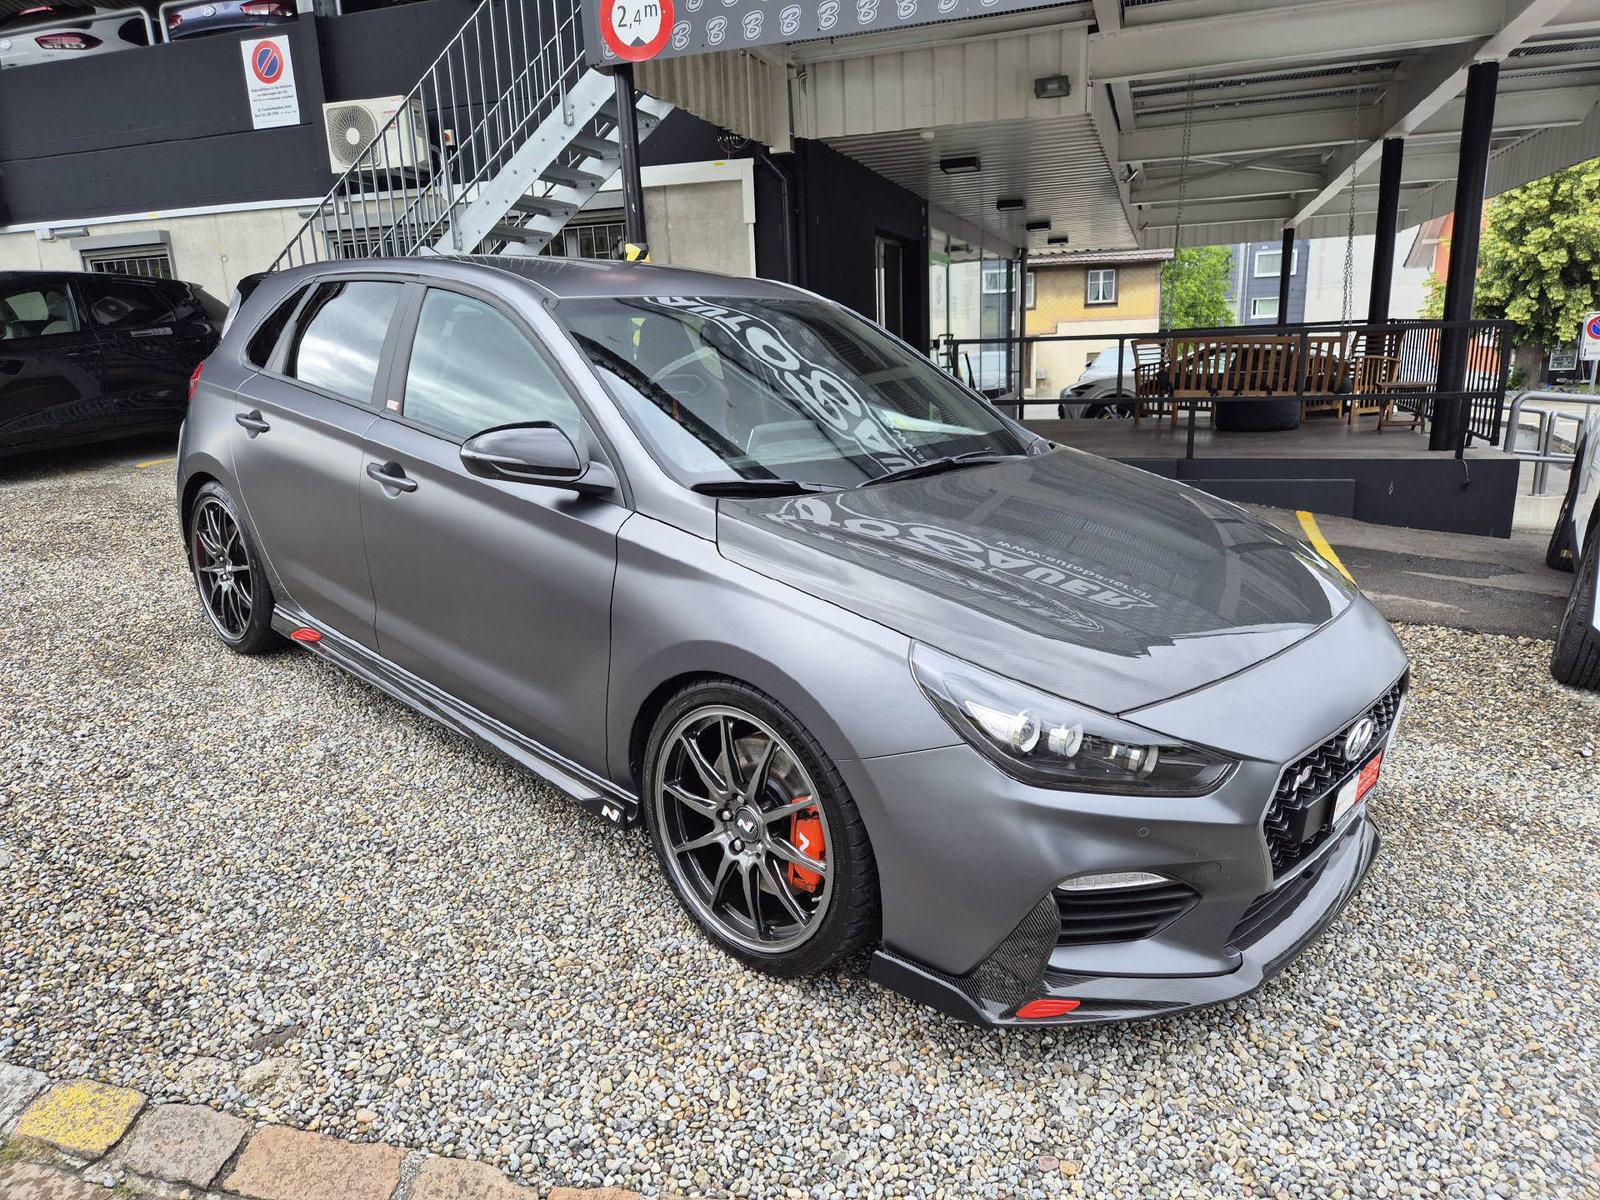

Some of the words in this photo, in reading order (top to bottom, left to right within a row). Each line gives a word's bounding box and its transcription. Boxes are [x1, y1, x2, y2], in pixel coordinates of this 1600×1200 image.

[617, 5, 642, 29] 2,4
[644, 3, 658, 18] m
[706, 16, 727, 45] B
[743, 10, 764, 40] B
[780, 5, 801, 35] B
[818, 0, 839, 30] B
